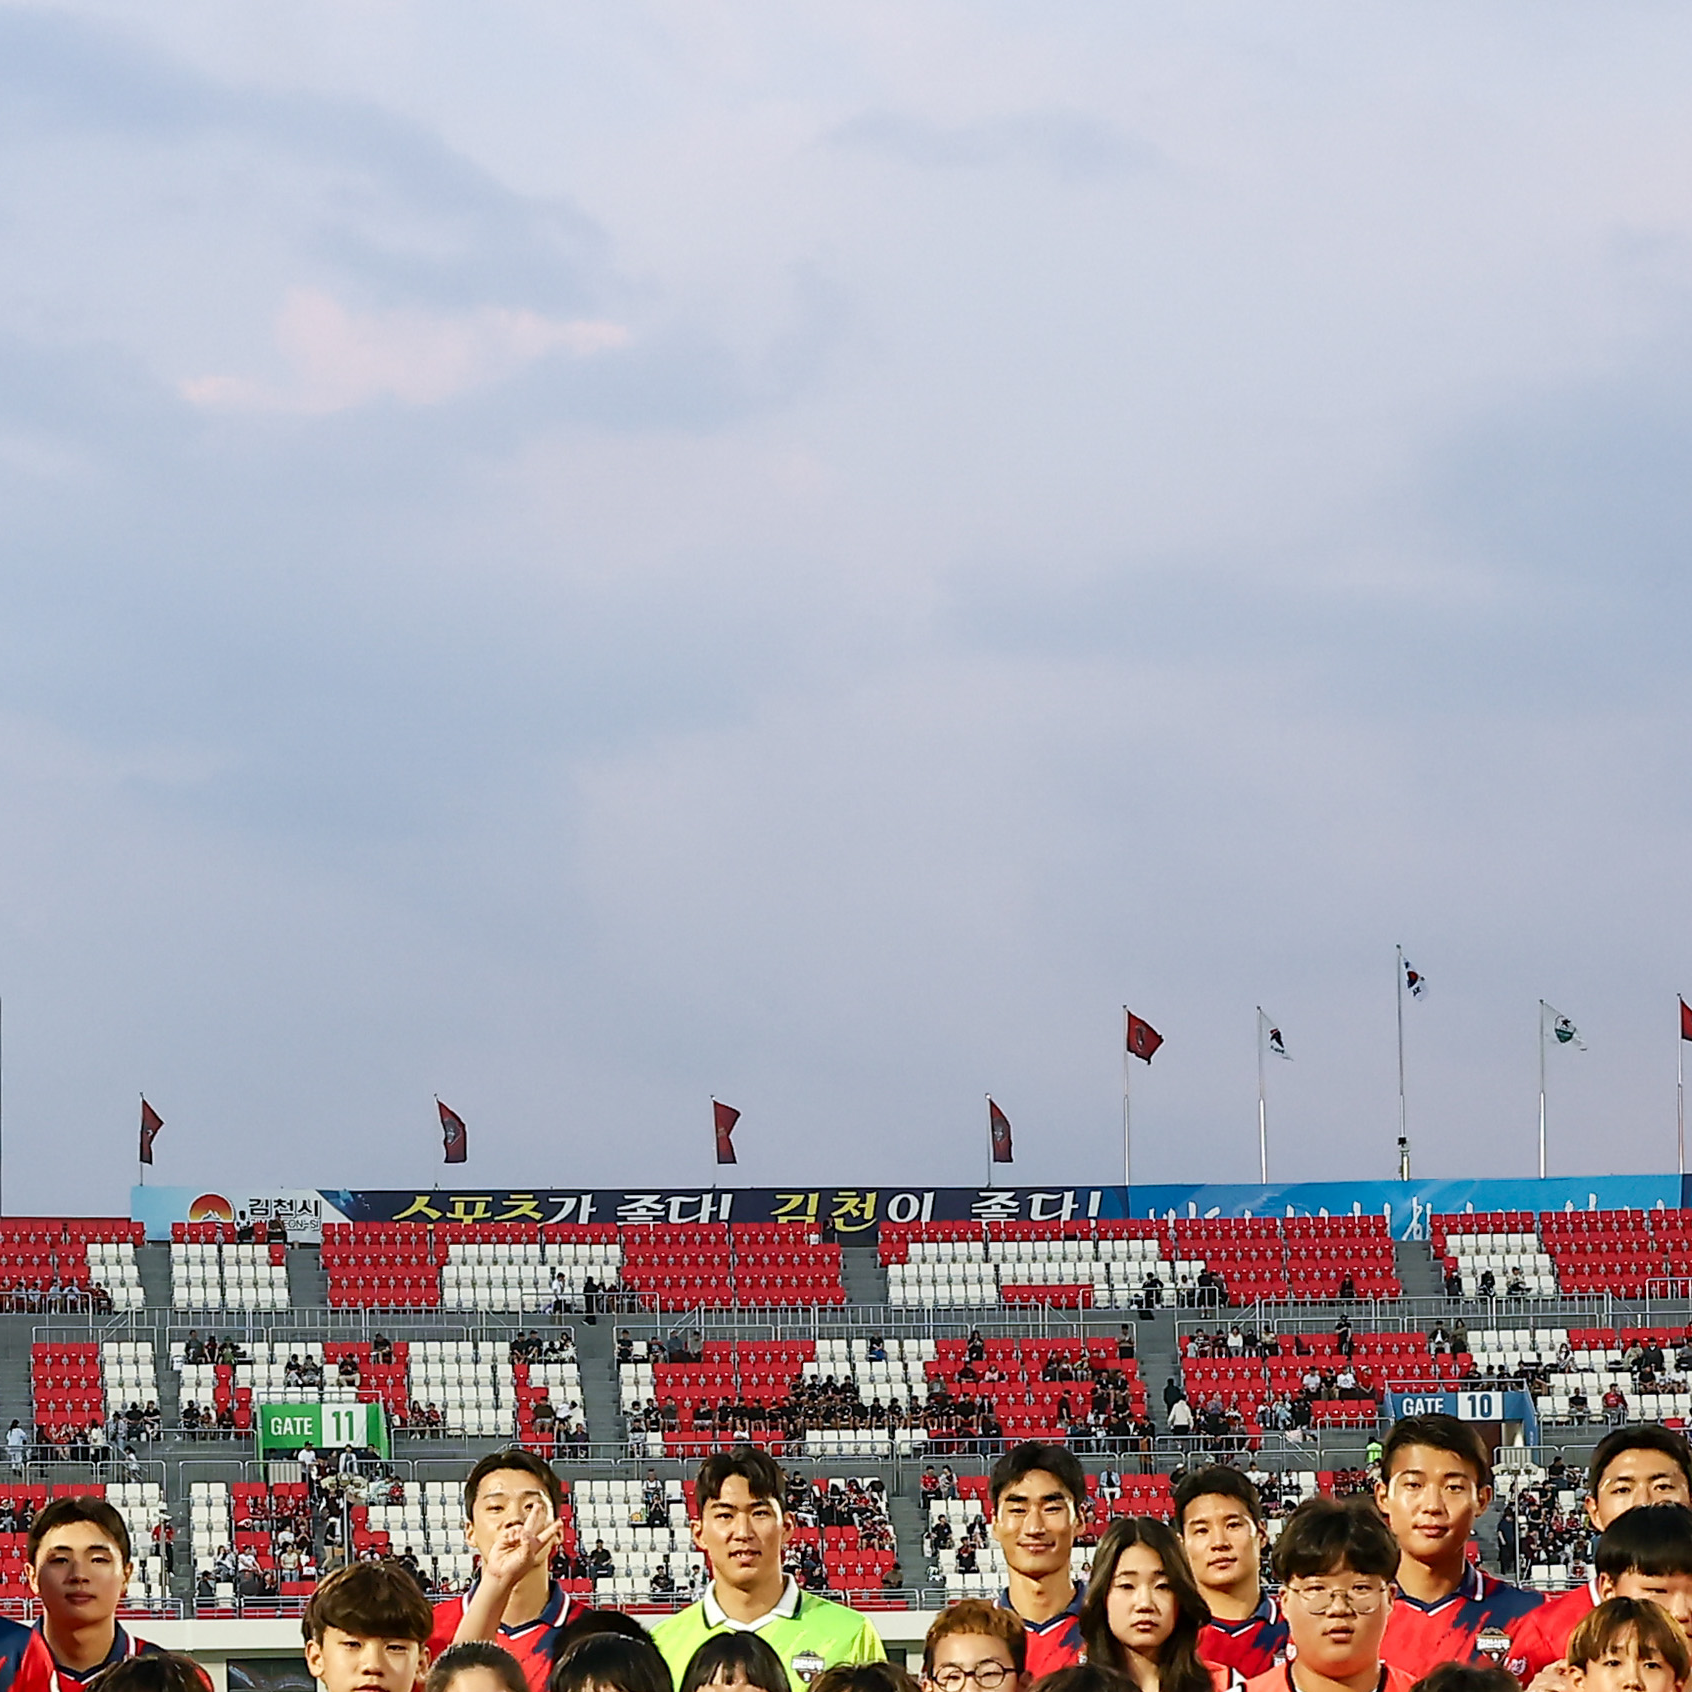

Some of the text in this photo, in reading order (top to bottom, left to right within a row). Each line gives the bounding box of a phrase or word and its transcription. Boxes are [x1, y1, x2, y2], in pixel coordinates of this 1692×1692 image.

[249, 1198, 320, 1218] 김천시
[770, 1191, 935, 1232] 김천이
[1402, 1394, 1491, 1419] GATE 10
[269, 1410, 356, 1442] GATE 11
